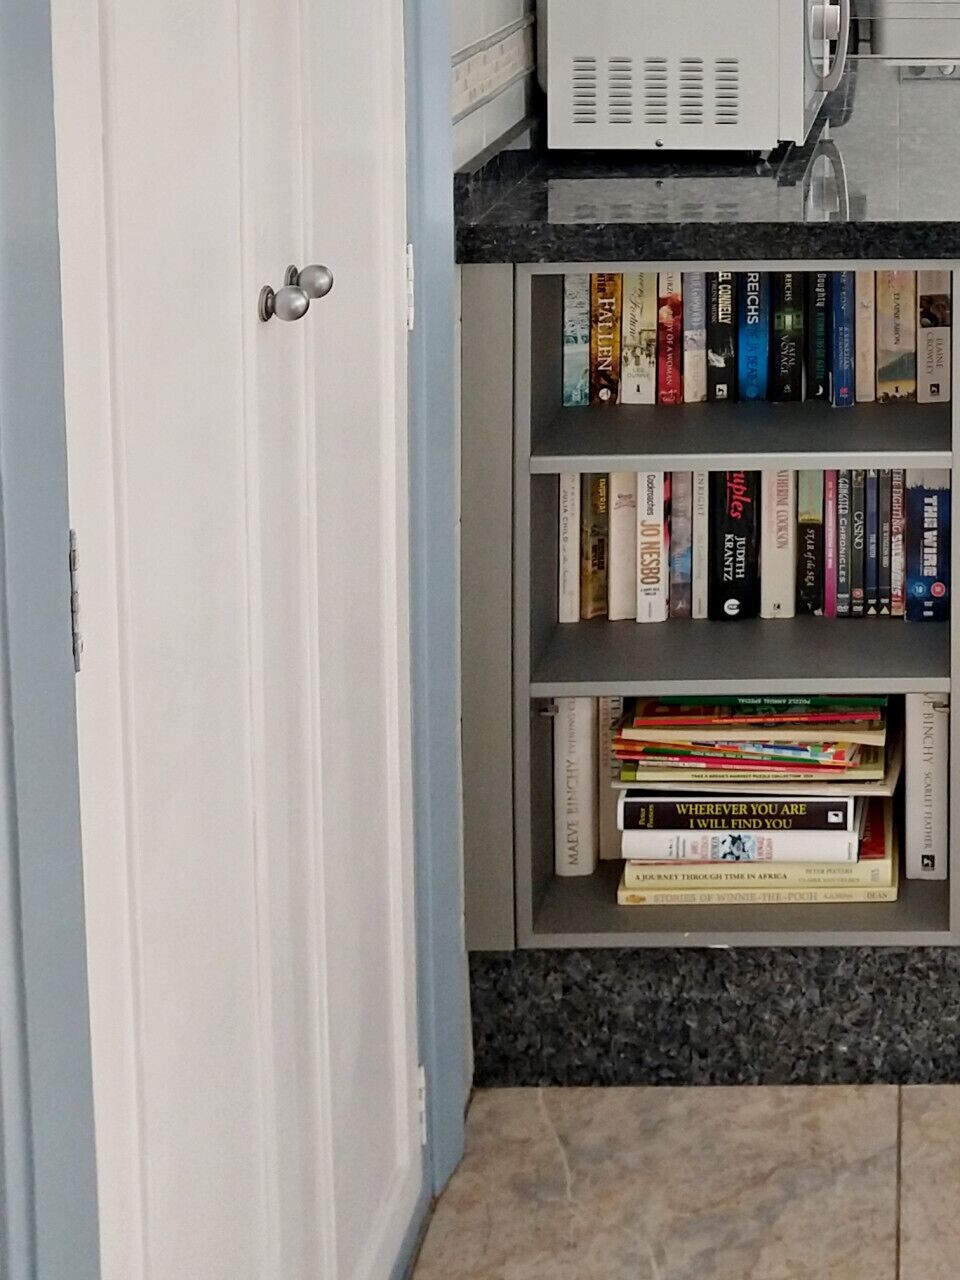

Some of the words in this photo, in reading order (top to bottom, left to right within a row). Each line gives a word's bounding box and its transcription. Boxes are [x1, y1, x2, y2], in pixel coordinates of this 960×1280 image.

[718, 284, 732, 324] CONNELLY
[746, 272, 760, 325] REICHS
[784, 273, 793, 301] REICHS
[814, 273, 828, 308] Doughty
[597, 297, 617, 372] FALLEN
[666, 335, 674, 344] OF
[665, 353, 673, 385] WOMAN
[780, 335, 790, 376] VOYAGE
[788, 342, 796, 366] FATAL
[926, 331, 936, 376] CROWLEY
[935, 338, 944, 369] ELAINE
[646, 474, 656, 516] Cockroaches
[727, 471, 751, 520] uples
[775, 470, 790, 506] ATHERINE
[837, 478, 849, 515] GANGSTER
[891, 487, 904, 532] FIGHTING
[923, 494, 938, 528] THE
[640, 519, 661, 538] JO
[805, 528, 815, 551] STAR
[853, 510, 864, 550] CASINO
[640, 541, 661, 585] NESBO
[723, 533, 735, 582] KRANTZ
[735, 536, 746, 579] JUDITH
[803, 551, 814, 559] of
[838, 517, 848, 584] CHRONICLES
[923, 529, 938, 577] WIRE
[804, 570, 815, 587] SEA
[922, 711, 935, 765] BINCHY
[566, 759, 579, 815] BINCHY
[676, 803, 749, 816] WHEREVER
[750, 803, 780, 816] YOU
[781, 803, 808, 816] ARE
[689, 818, 696, 830] I
[697, 818, 730, 830] WILL
[731, 818, 763, 830] FIND
[764, 818, 794, 831] YOU
[567, 821, 580, 867] MAEVE
[635, 873, 641, 881] A
[642, 873, 678, 881] JOURNEY
[681, 873, 722, 881] THROUGH
[724, 873, 747, 881] TIME
[758, 872, 788, 880] AFRICA
[699, 893, 713, 903] OF
[867, 891, 889, 900] DEAN
